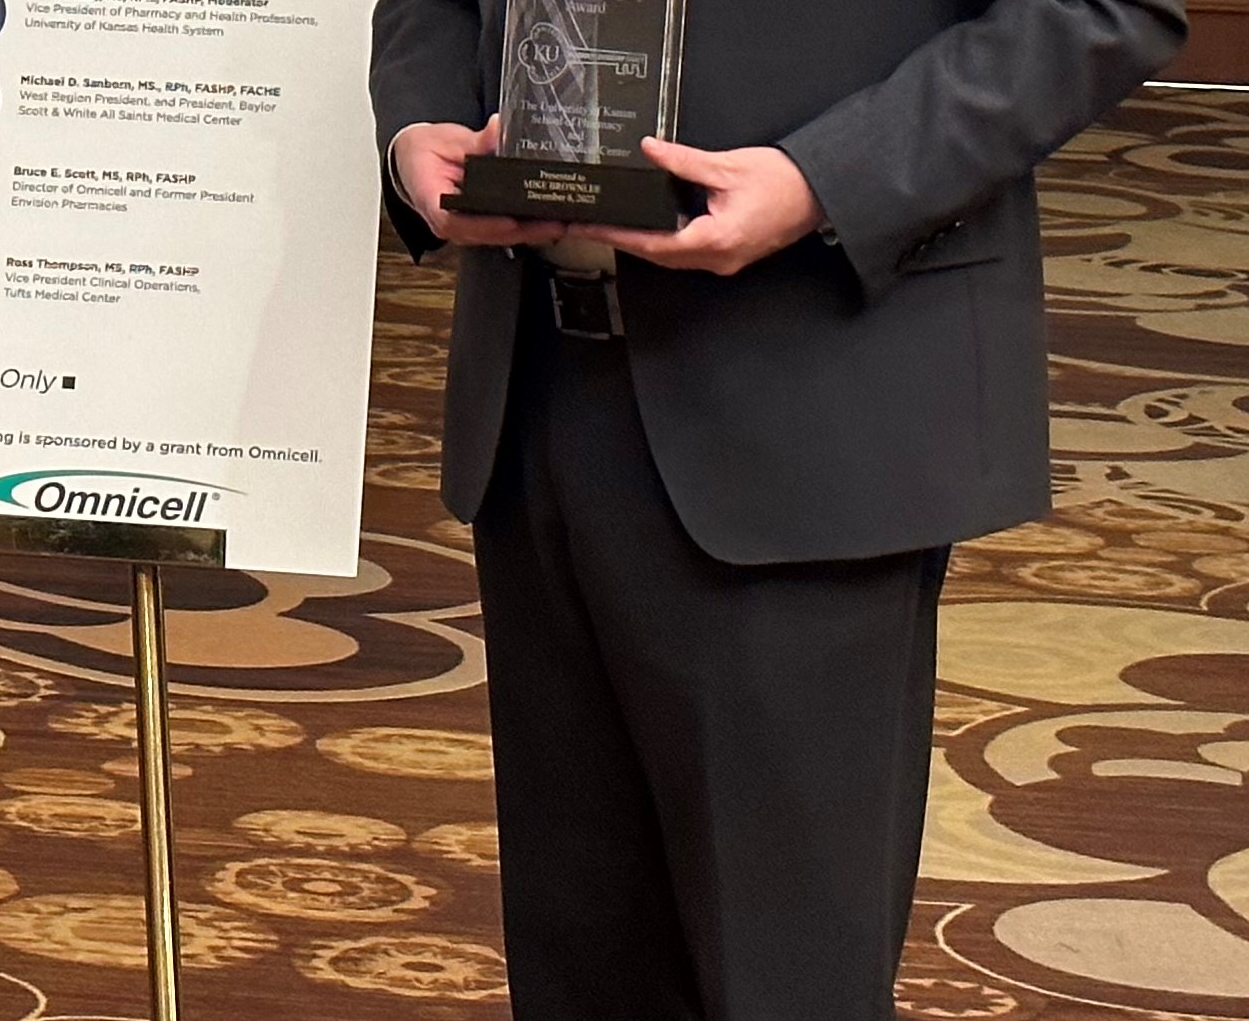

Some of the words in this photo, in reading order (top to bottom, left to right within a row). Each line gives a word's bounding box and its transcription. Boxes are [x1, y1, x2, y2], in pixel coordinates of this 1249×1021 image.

[26, 3, 51, 13] Vice
[52, 4, 107, 16] President
[109, 6, 123, 16] of
[124, 7, 182, 20] Pharmacy
[184, 11, 207, 20] and
[209, 11, 247, 22] Health
[249, 13, 319, 26] Professions,
[566, 0, 606, 14] Award
[24, 18, 82, 31] University
[83, 20, 97, 30] of
[98, 22, 139, 32] Kansas
[141, 24, 180, 34] Health
[181, 25, 225, 36] System
[534, 44, 560, 64] KU
[20, 76, 65, 86] Michael
[68, 77, 79, 87] D.
[82, 78, 135, 91] Sanborn,
[239, 86, 281, 96] FACHE
[19, 90, 49, 101] West
[51, 92, 92, 104] Region
[154, 98, 176, 107] and
[238, 101, 277, 113] Baylor
[17, 105, 49, 116] Scott
[51, 108, 60, 117] &
[62, 108, 98, 118] White
[99, 110, 116, 119] All
[117, 110, 153, 121] Saints
[156, 112, 201, 123] Medical
[202, 114, 243, 125] Center
[13, 166, 48, 176] Bruce
[50, 168, 62, 177] E.
[64, 169, 99, 181] Scott,
[101, 171, 123, 182] MS,
[155, 174, 197, 184] FASHP
[523, 179, 546, 190] MIKE
[12, 181, 59, 192] Director
[60, 184, 74, 193] of
[76, 184, 128, 196] Omnicell
[128, 188, 152, 198] and
[154, 188, 198, 199] Former
[200, 191, 255, 203] President
[10, 196, 59, 208] Envision
[61, 199, 128, 212] Pharmacies
[6, 258, 34, 268] Ross
[36, 259, 102, 272] Thompson,
[104, 263, 126, 274] MS,
[158, 266, 200, 276] FASHP
[4, 272, 30, 283] Vice
[32, 274, 87, 286] President
[89, 277, 131, 288] Clinical
[3, 288, 32, 298] Tufts
[34, 290, 79, 301] Medical
[81, 292, 121, 303] Center
[1, 369, 57, 394] Only
[18, 431, 31, 444] is
[34, 436, 118, 449] sponsored
[122, 438, 142, 453] by
[145, 442, 155, 451] a
[159, 443, 202, 455] grant
[206, 443, 244, 457] from
[248, 446, 323, 462] Omnicell.
[32, 479, 210, 524] Omnicell
